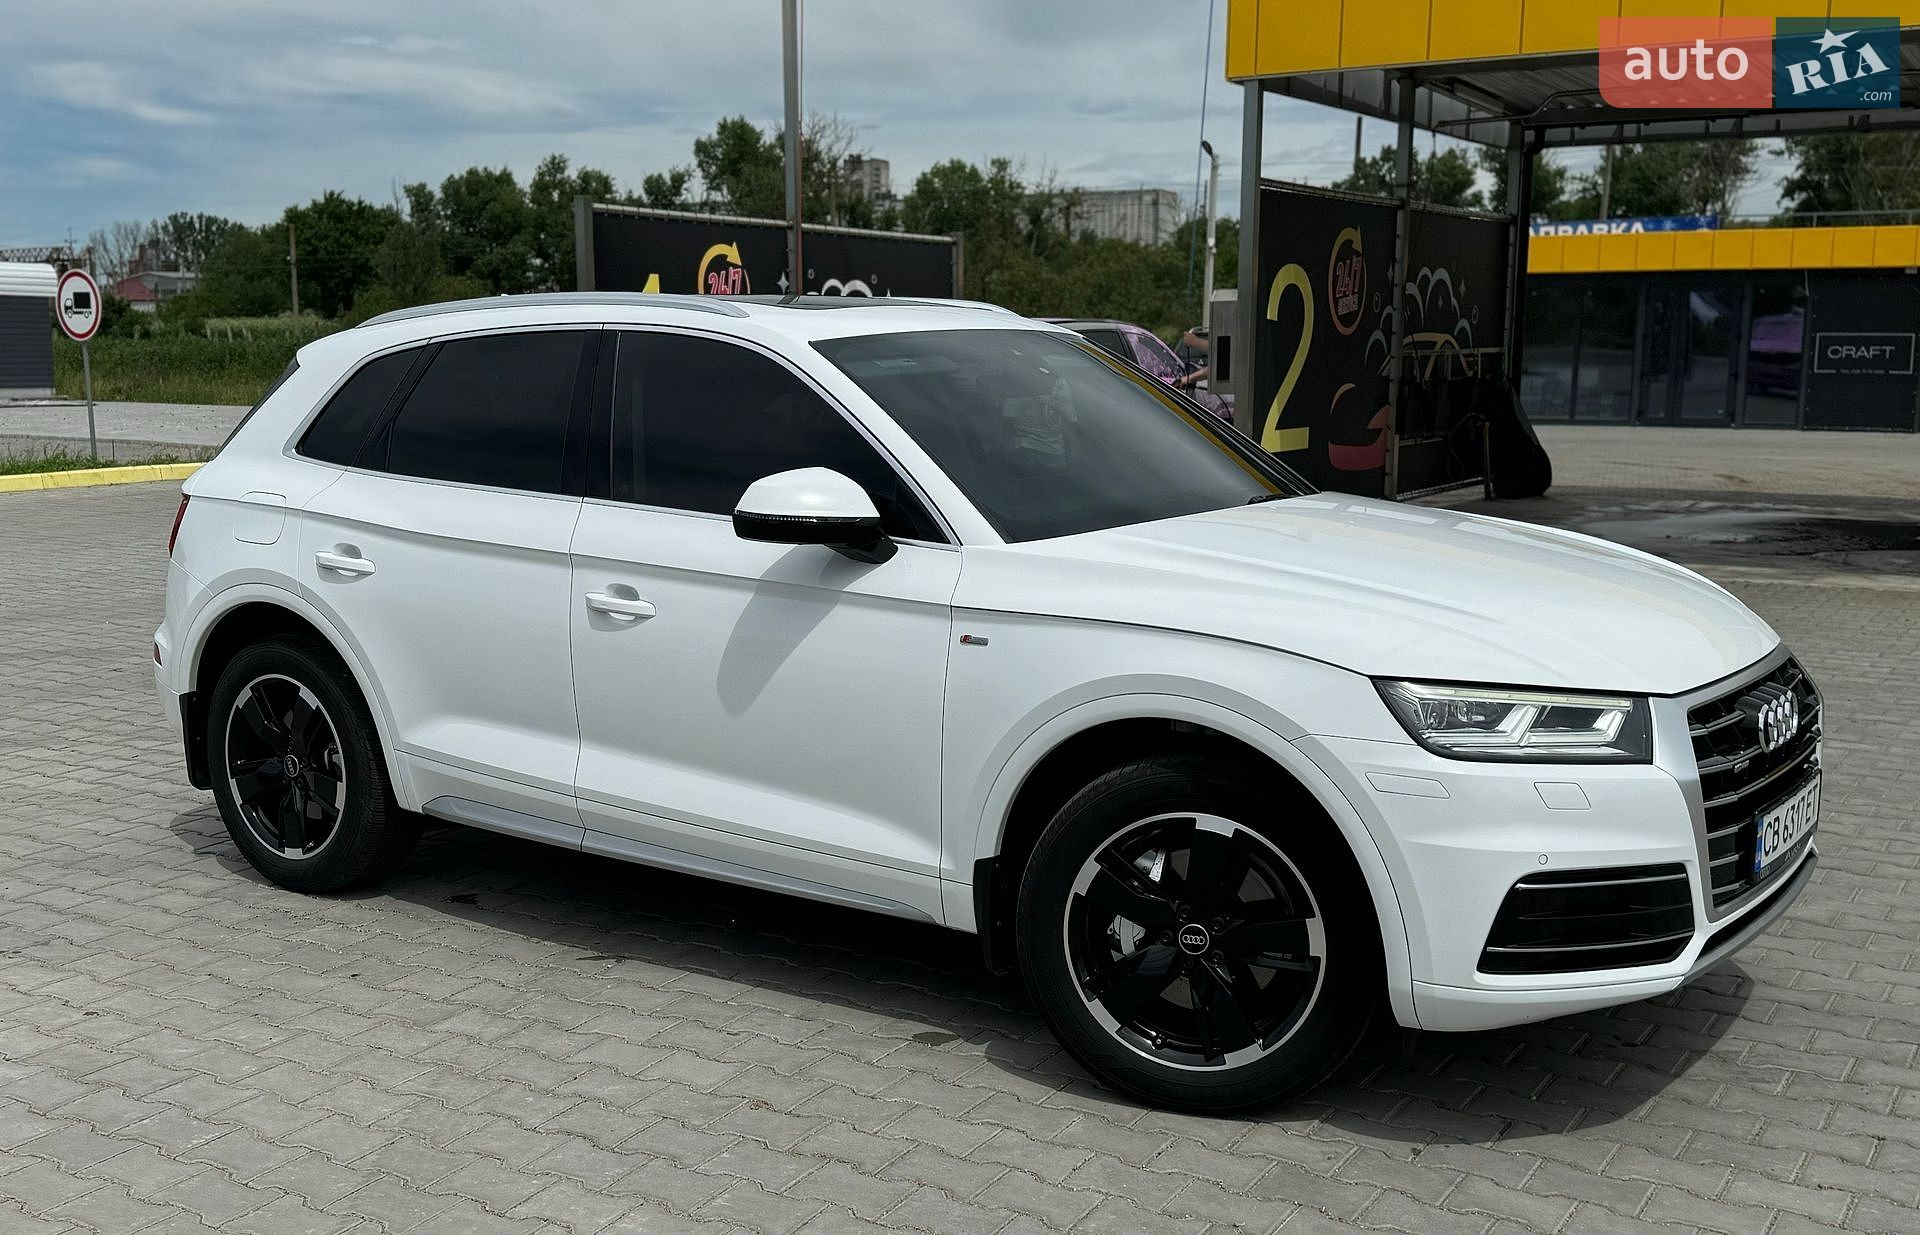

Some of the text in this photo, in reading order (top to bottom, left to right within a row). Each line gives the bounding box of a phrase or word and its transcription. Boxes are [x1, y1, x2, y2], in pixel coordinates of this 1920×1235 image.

[1261, 263, 1314, 453] 2
[1827, 345, 1896, 359] CRAFT
[1763, 815, 1780, 857] CB
